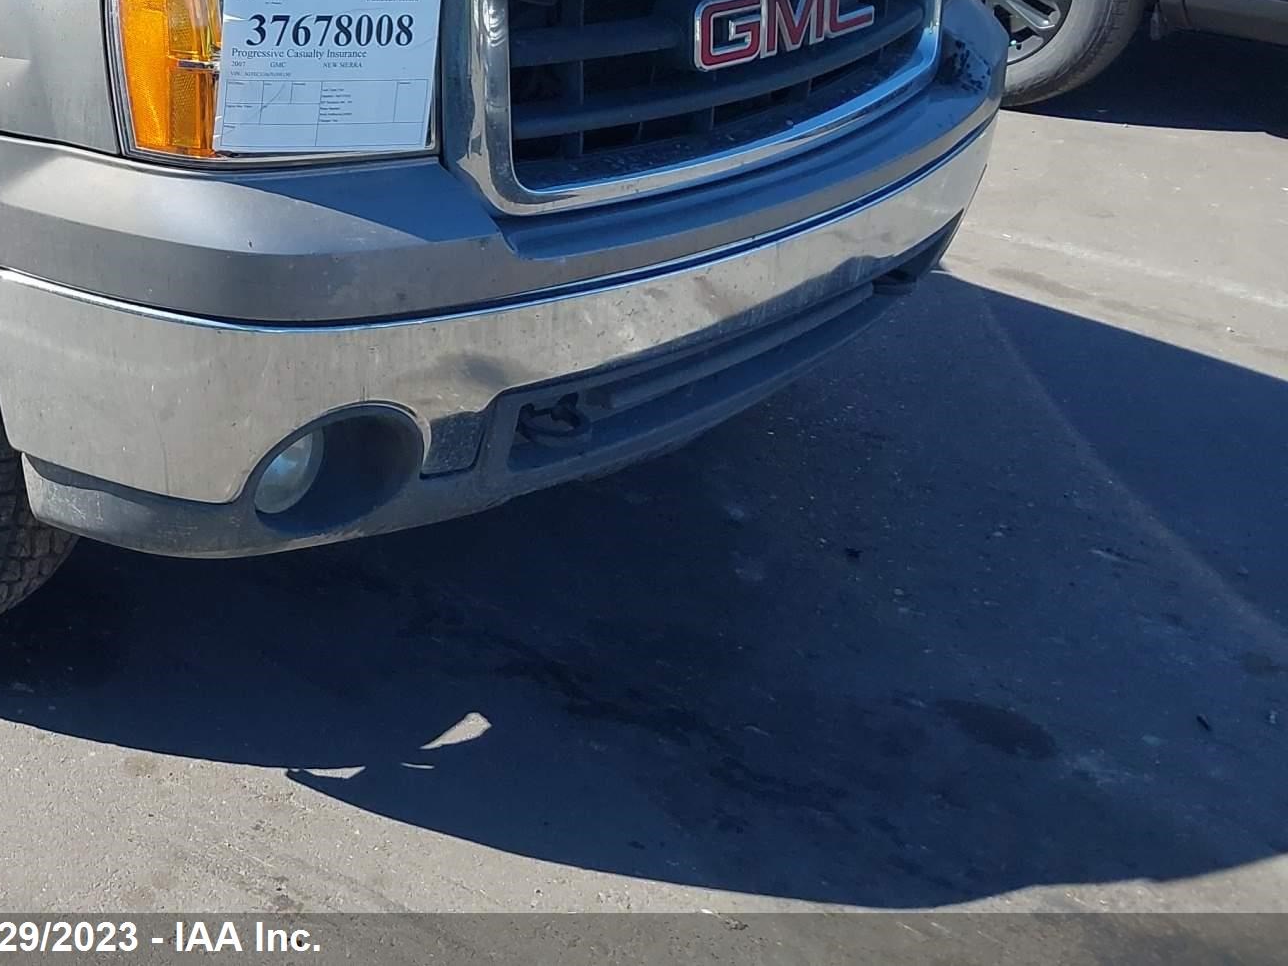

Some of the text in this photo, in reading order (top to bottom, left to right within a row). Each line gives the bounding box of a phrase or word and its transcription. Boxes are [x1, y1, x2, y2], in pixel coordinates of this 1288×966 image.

[245, 13, 414, 47] 37678008
[231, 47, 368, 60] Progressive Casualty Insurance
